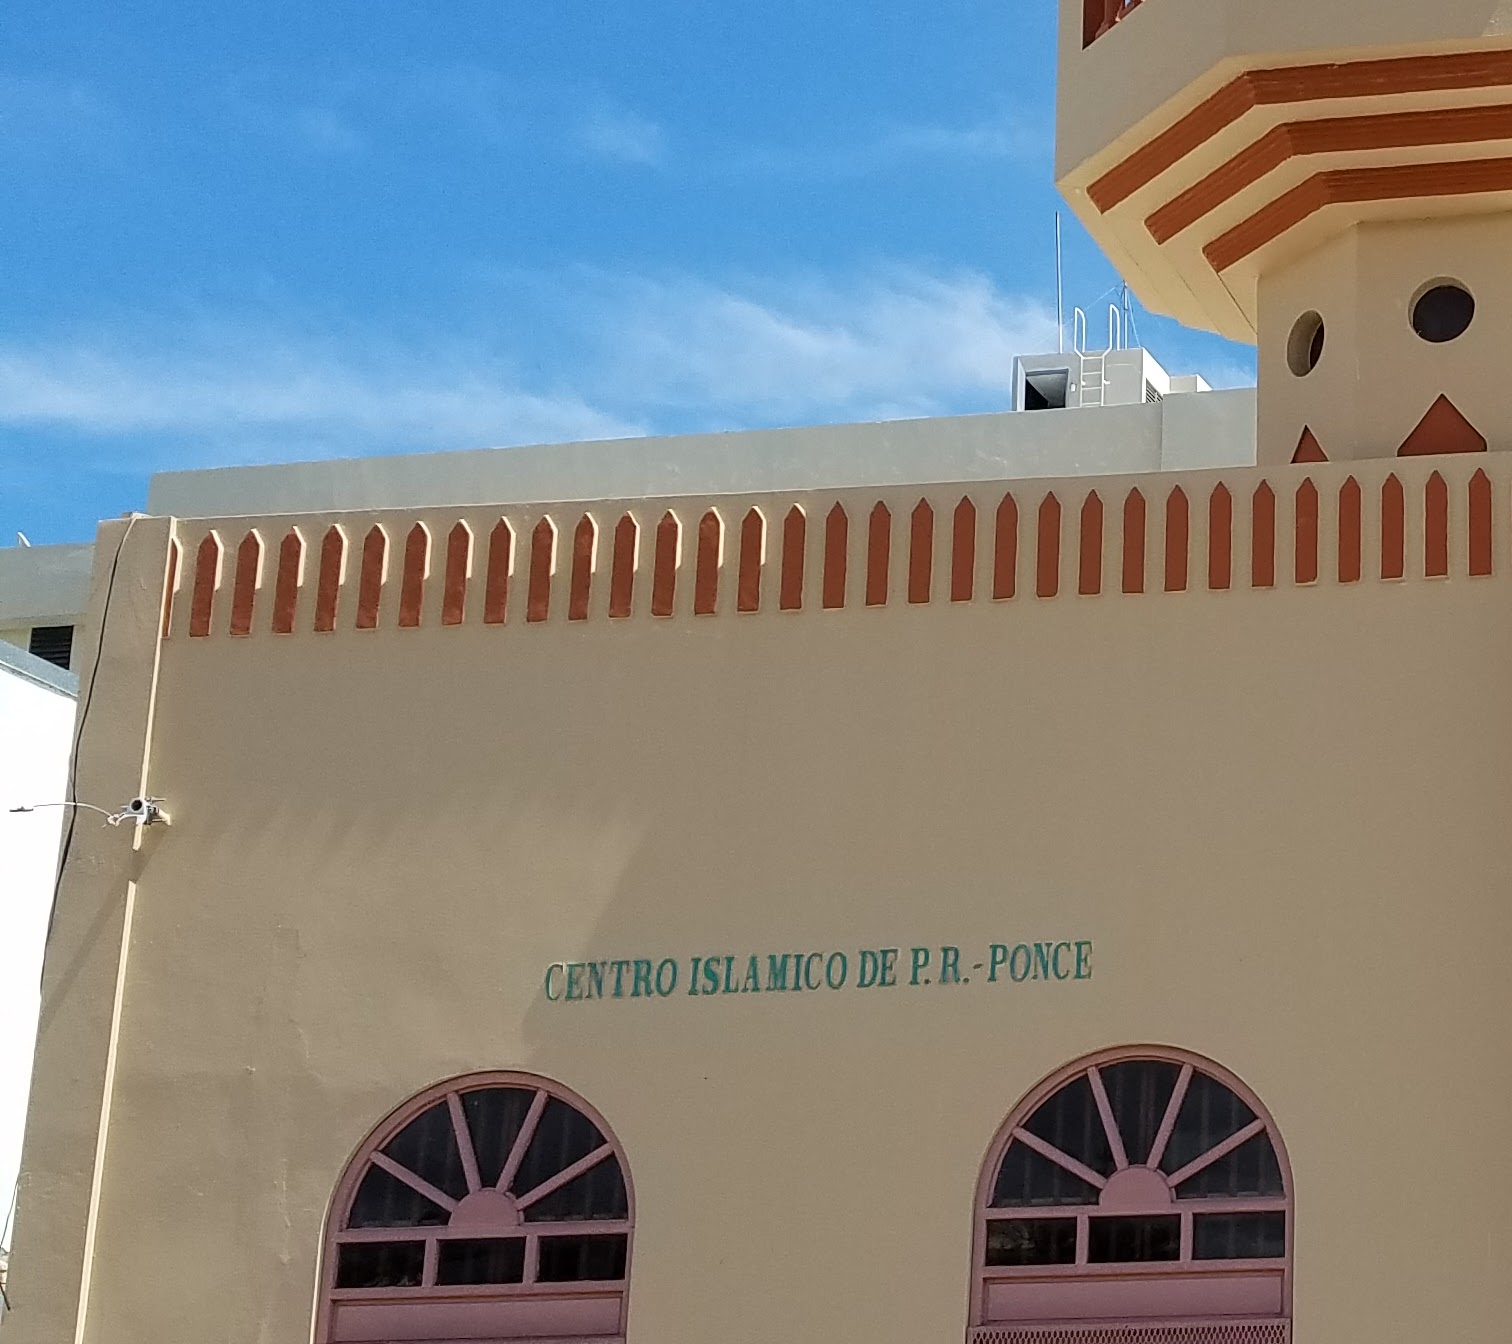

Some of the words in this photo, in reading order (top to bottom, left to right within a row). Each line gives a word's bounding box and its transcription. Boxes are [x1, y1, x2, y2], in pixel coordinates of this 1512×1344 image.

[544, 956, 678, 1001] CENTRO
[688, 952, 848, 996] ISLAMICO
[857, 947, 898, 988] DE
